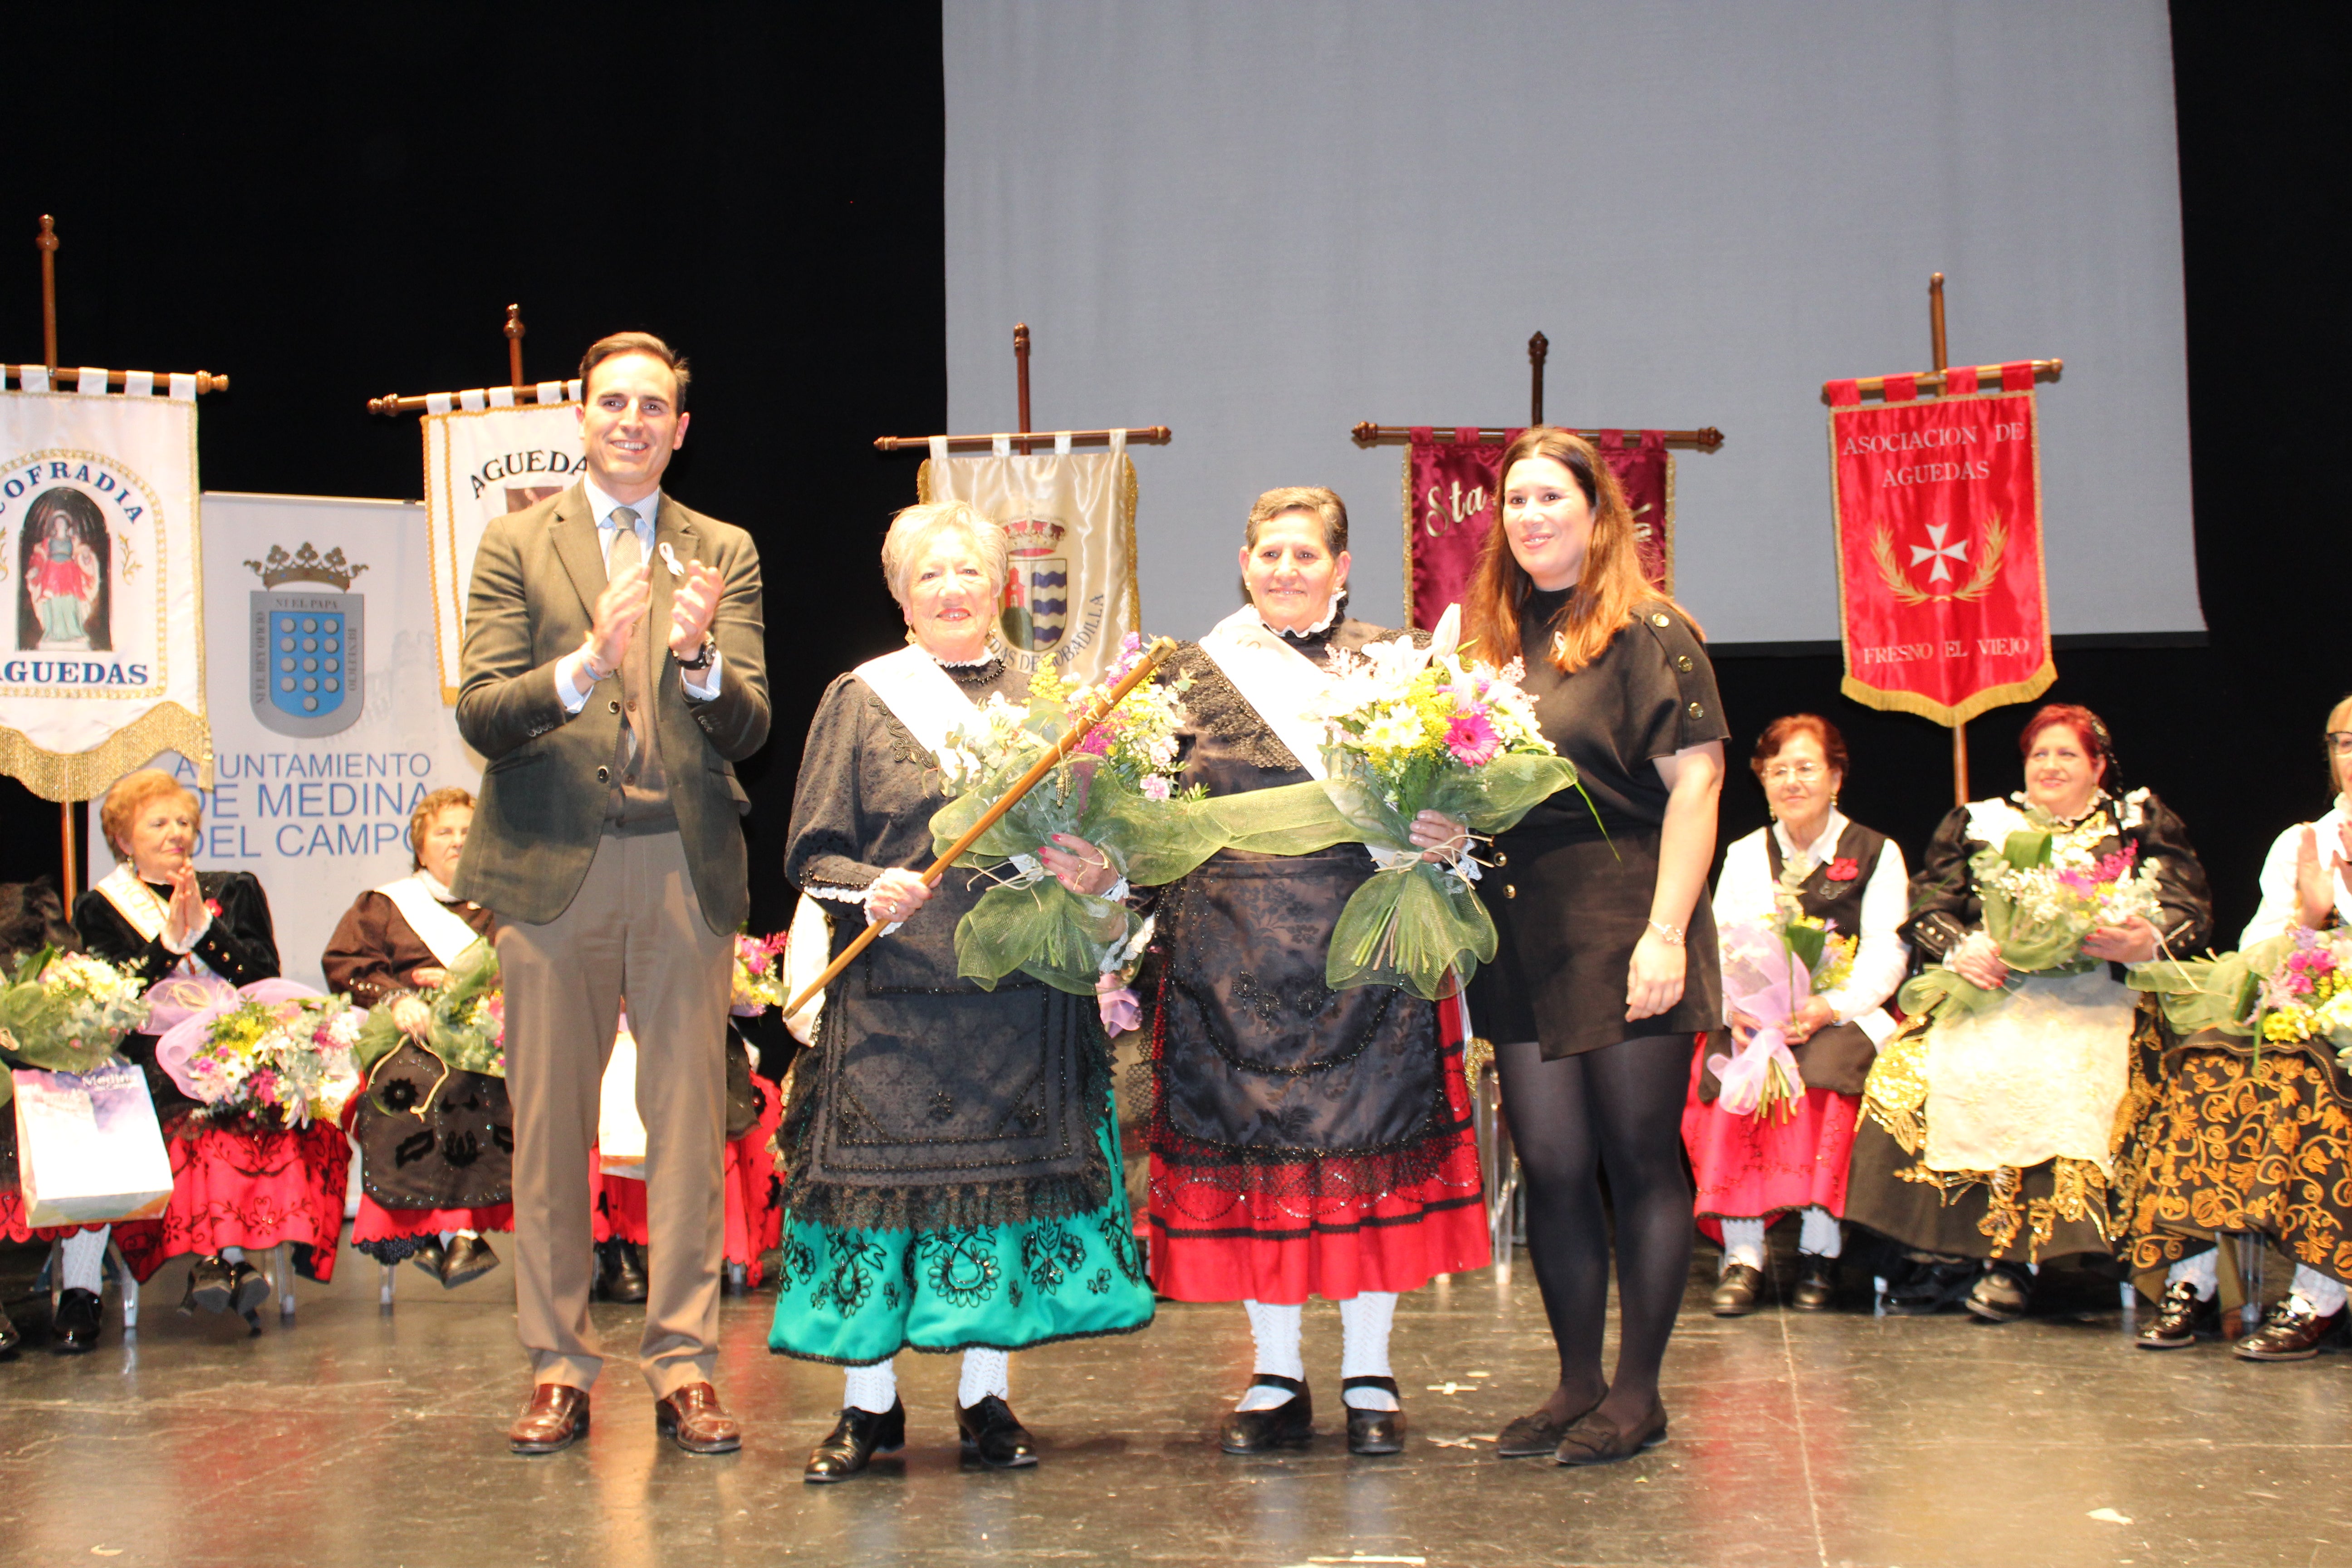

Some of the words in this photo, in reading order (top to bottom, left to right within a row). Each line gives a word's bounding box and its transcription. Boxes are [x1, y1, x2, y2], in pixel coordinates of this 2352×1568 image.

[1843, 426, 1977, 456] ASOCIACION
[1996, 422, 2026, 442] DE
[1882, 461, 1990, 488] AGUEDAS
[0, 461, 143, 524] OFRADIA
[1045, 594, 1104, 667] OBADILLA
[1864, 643, 1933, 664] FRESNO
[1945, 640, 1968, 657] EL
[1977, 637, 2029, 657] VIEJO
[0, 661, 148, 685] GUEDAS
[175, 752, 431, 779] AUNTAMIENTO
[257, 782, 428, 818] MEDINA
